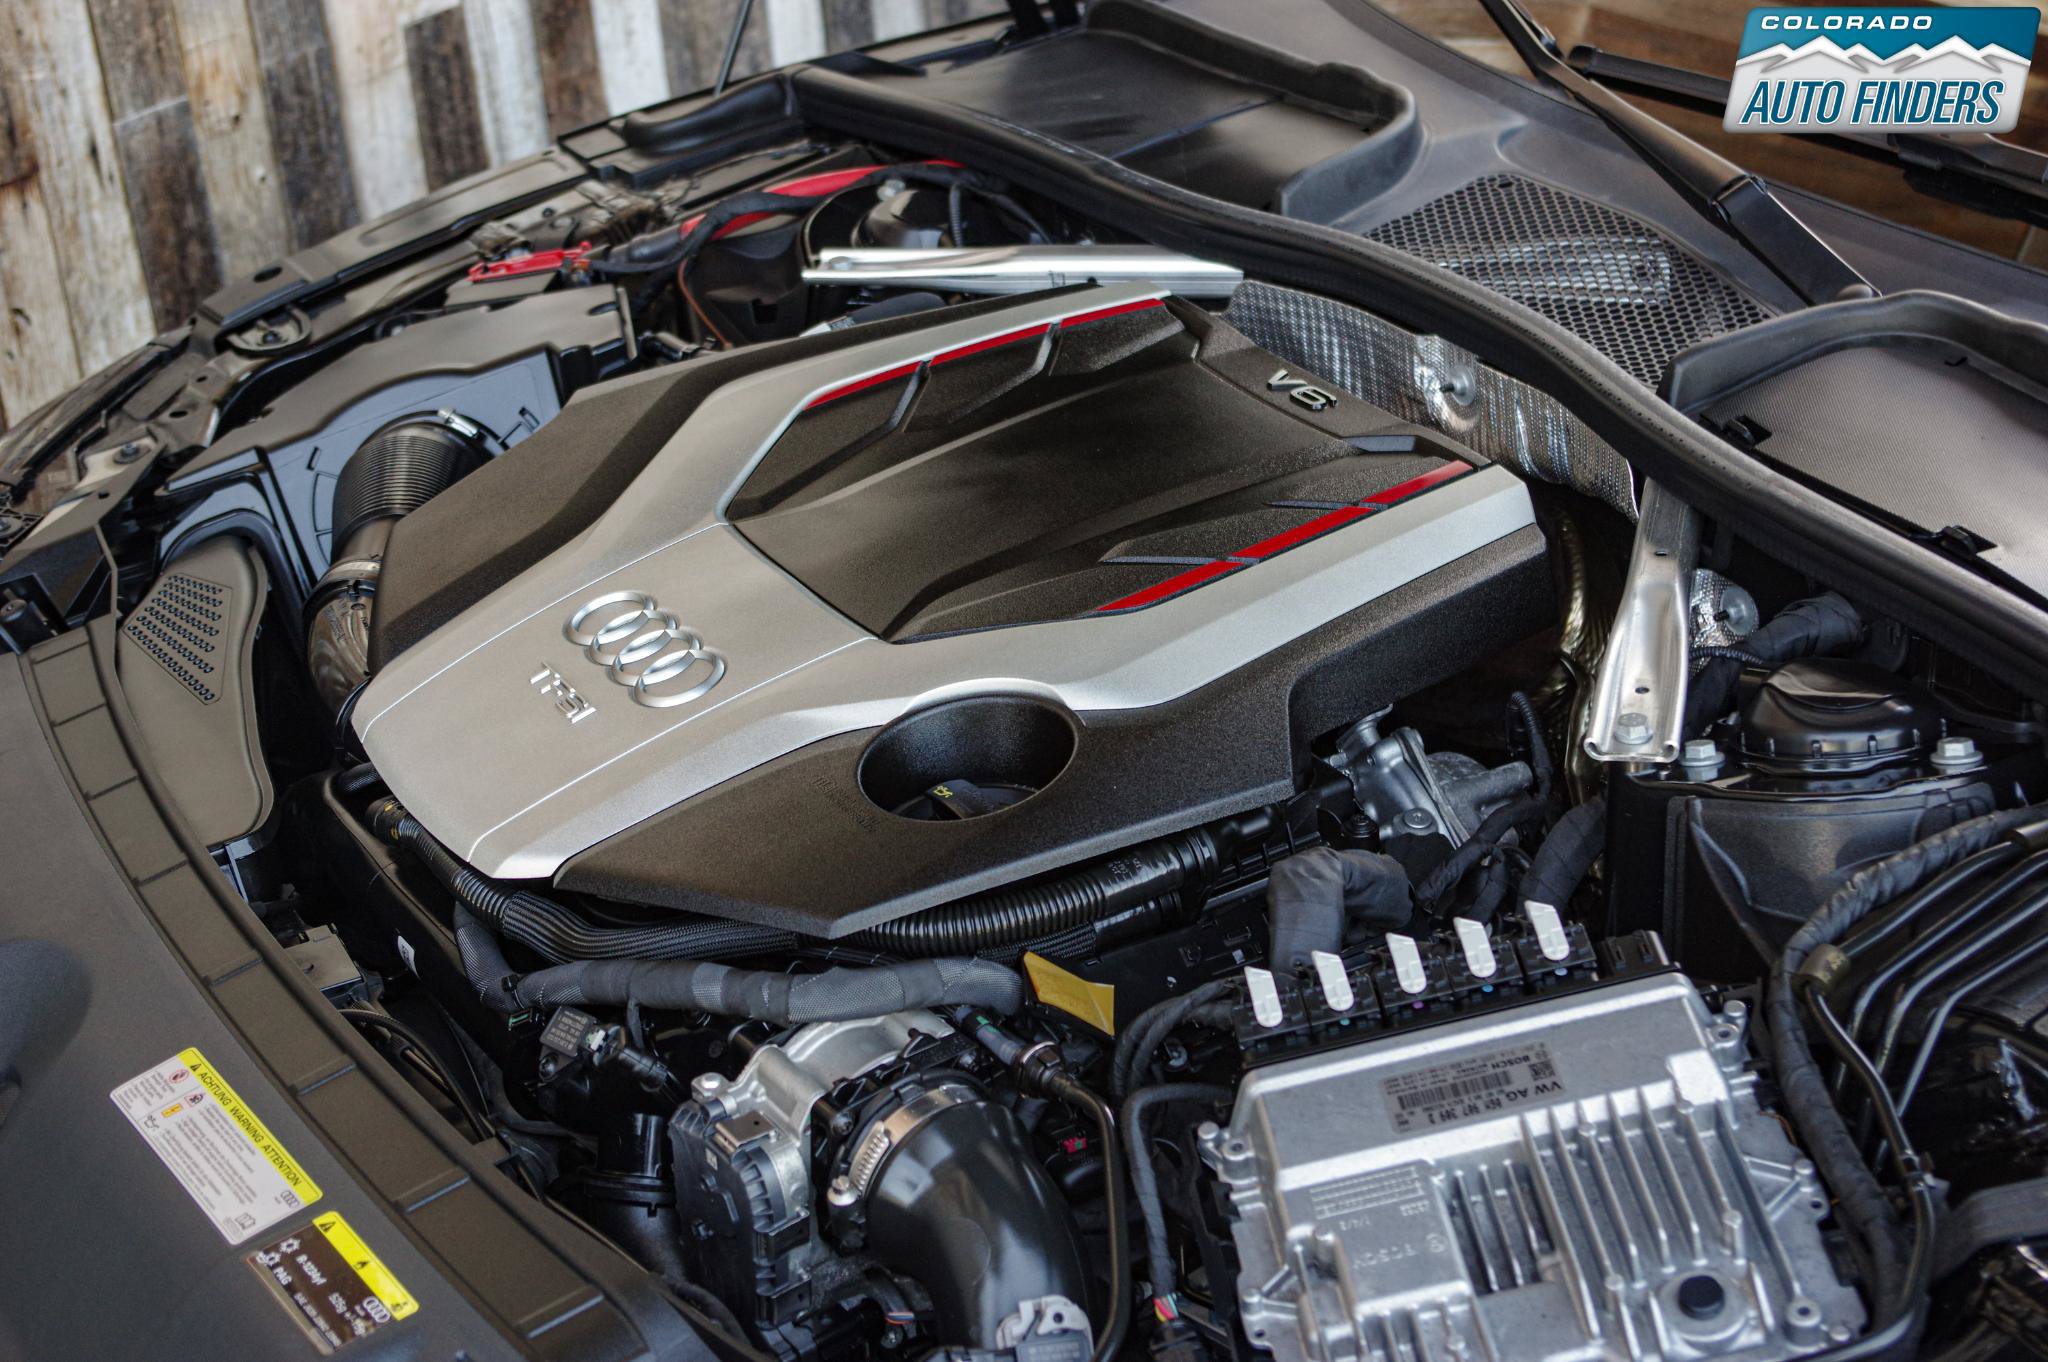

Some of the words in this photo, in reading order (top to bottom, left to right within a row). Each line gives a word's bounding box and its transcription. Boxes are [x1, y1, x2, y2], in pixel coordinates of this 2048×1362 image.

[1266, 369, 1337, 411] V6
[530, 662, 596, 724] TFSI
[1490, 1054, 1531, 1070] BOSCH
[1505, 1088, 1528, 1102] AG
[1535, 1081, 1563, 1095] VW
[200, 1072, 232, 1107] ACHTUNG
[230, 1105, 264, 1143] WARNING
[262, 1143, 301, 1187] ATTENTION
[273, 1266, 293, 1286] PAG
